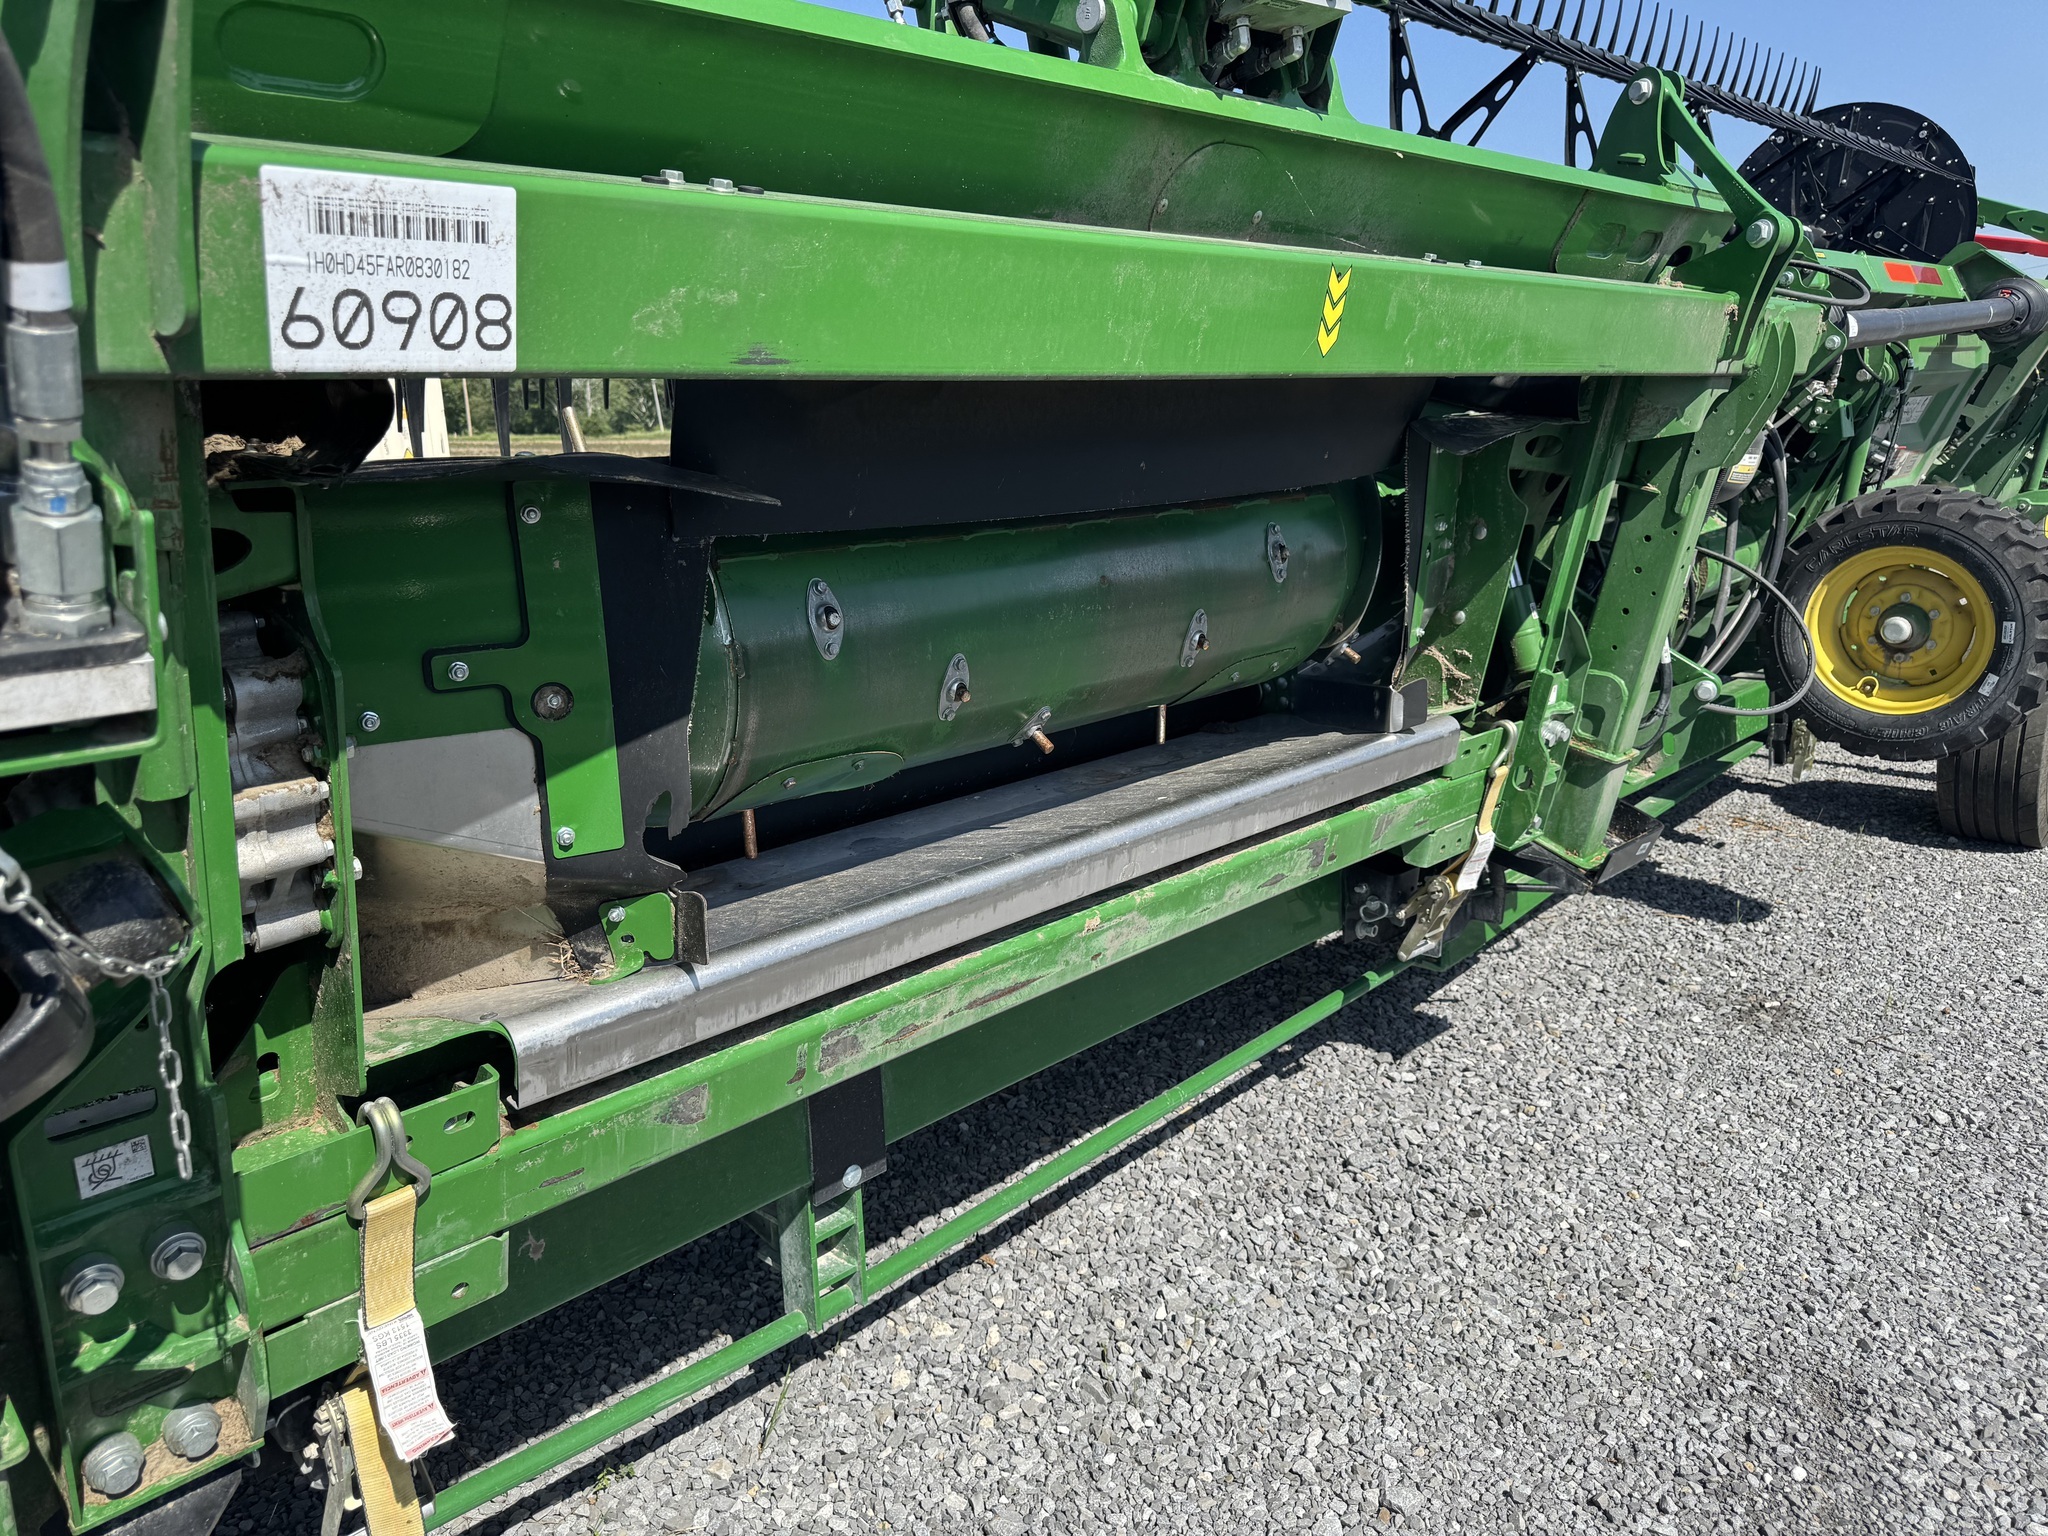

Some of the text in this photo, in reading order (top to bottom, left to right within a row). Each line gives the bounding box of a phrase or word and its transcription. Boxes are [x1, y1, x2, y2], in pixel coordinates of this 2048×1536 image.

[306, 252, 470, 280] 1H0HD45FAR0830182
[281, 287, 512, 351] 60908
[1805, 524, 1921, 572] CARLSTAR
[392, 1321, 409, 1334] 1513
[372, 1330, 391, 1342] KGS
[394, 1328, 412, 1341] 3335
[376, 1337, 393, 1349] LBS
